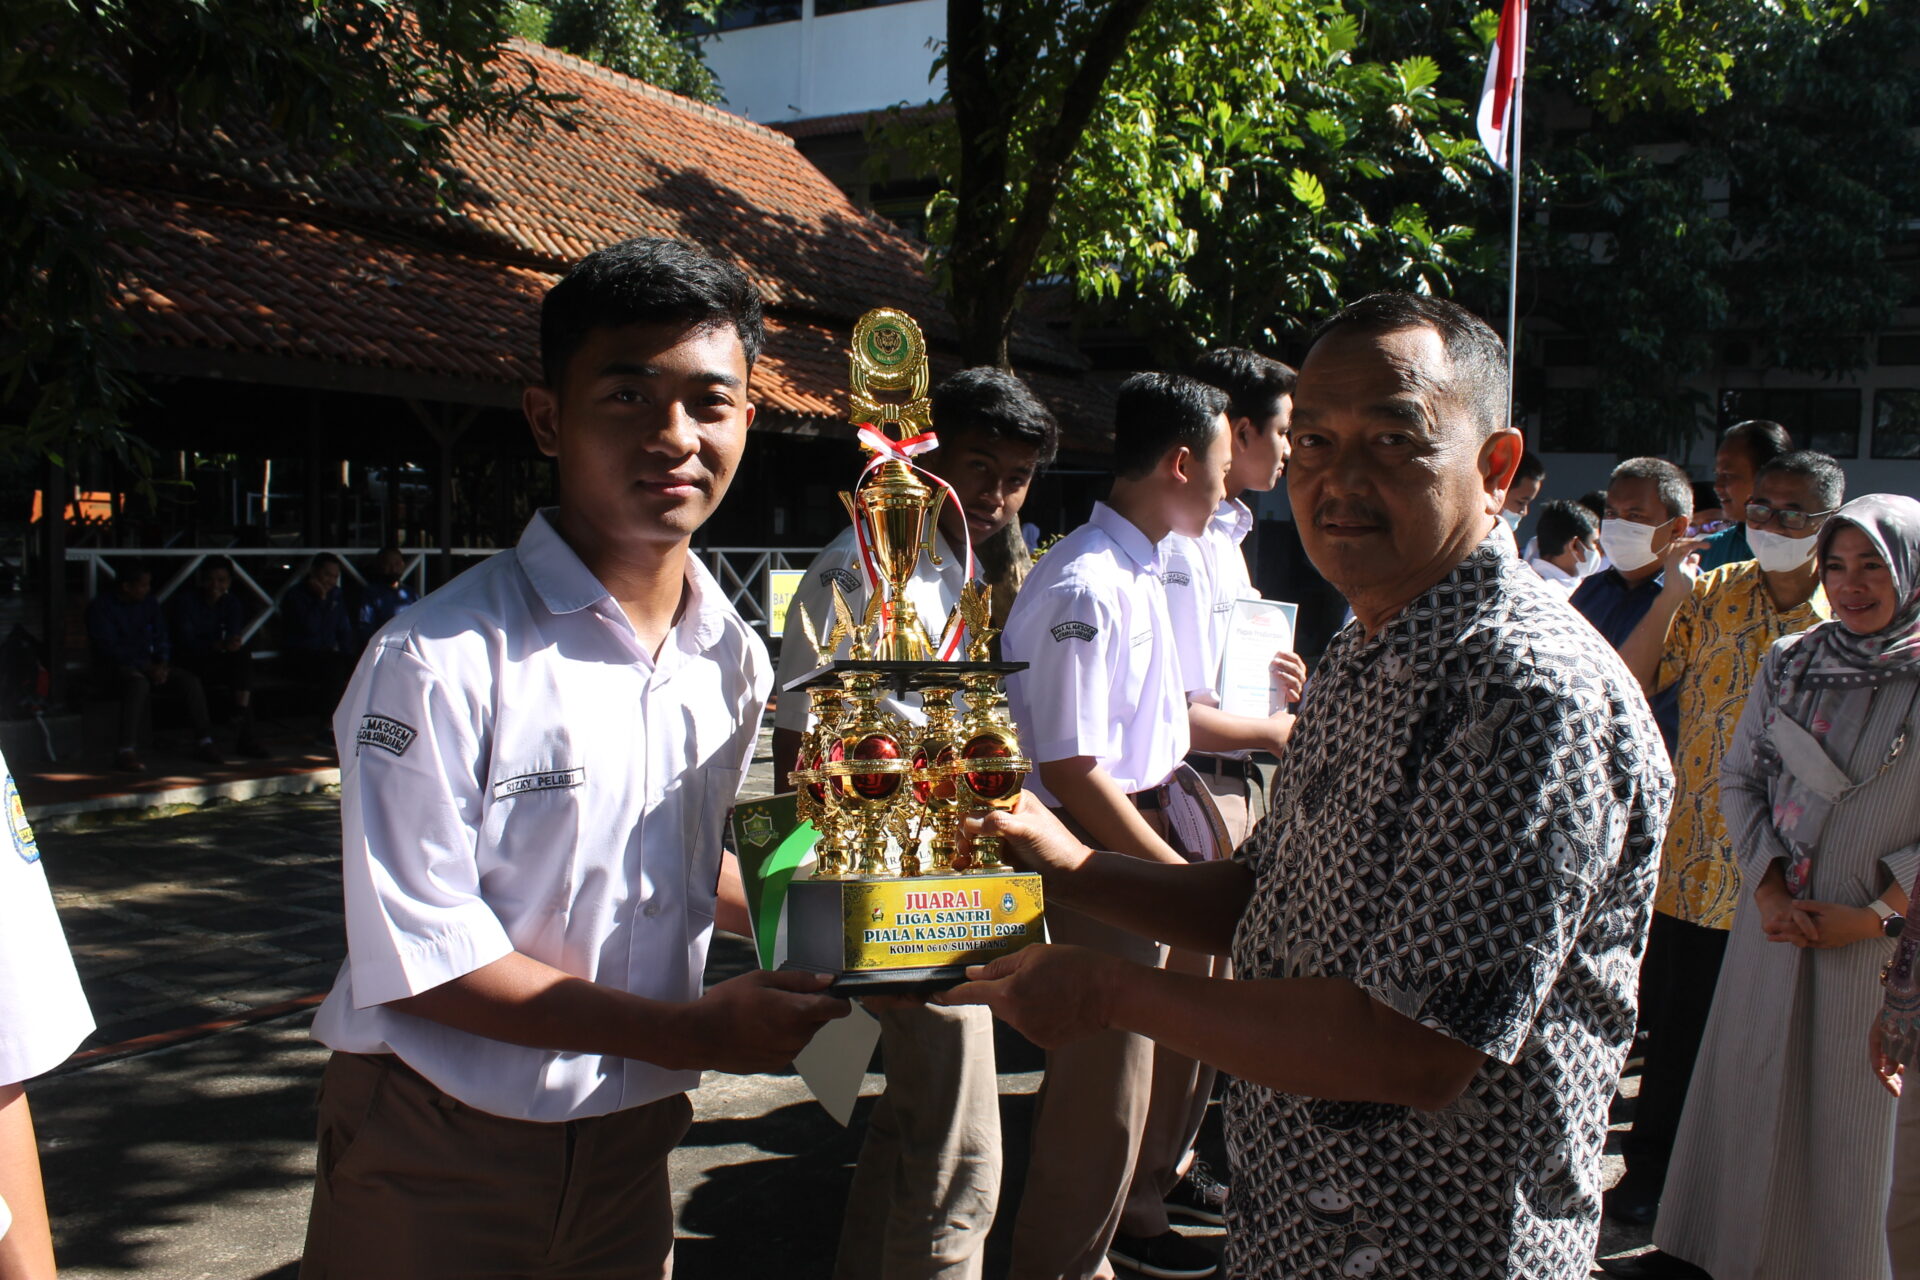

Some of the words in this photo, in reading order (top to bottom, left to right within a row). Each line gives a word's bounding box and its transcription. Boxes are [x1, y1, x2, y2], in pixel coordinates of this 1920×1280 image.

[506, 779, 532, 792] RIZKY
[906, 892, 968, 910] JUARA
[973, 891, 981, 907] I
[896, 912, 931, 925] LIGA
[936, 910, 991, 924] SANTRI
[864, 928, 910, 943] PIALA
[915, 925, 967, 940] KASAD
[971, 924, 991, 937] TH
[995, 924, 1026, 936] 2022
[890, 942, 924, 954] KODIM
